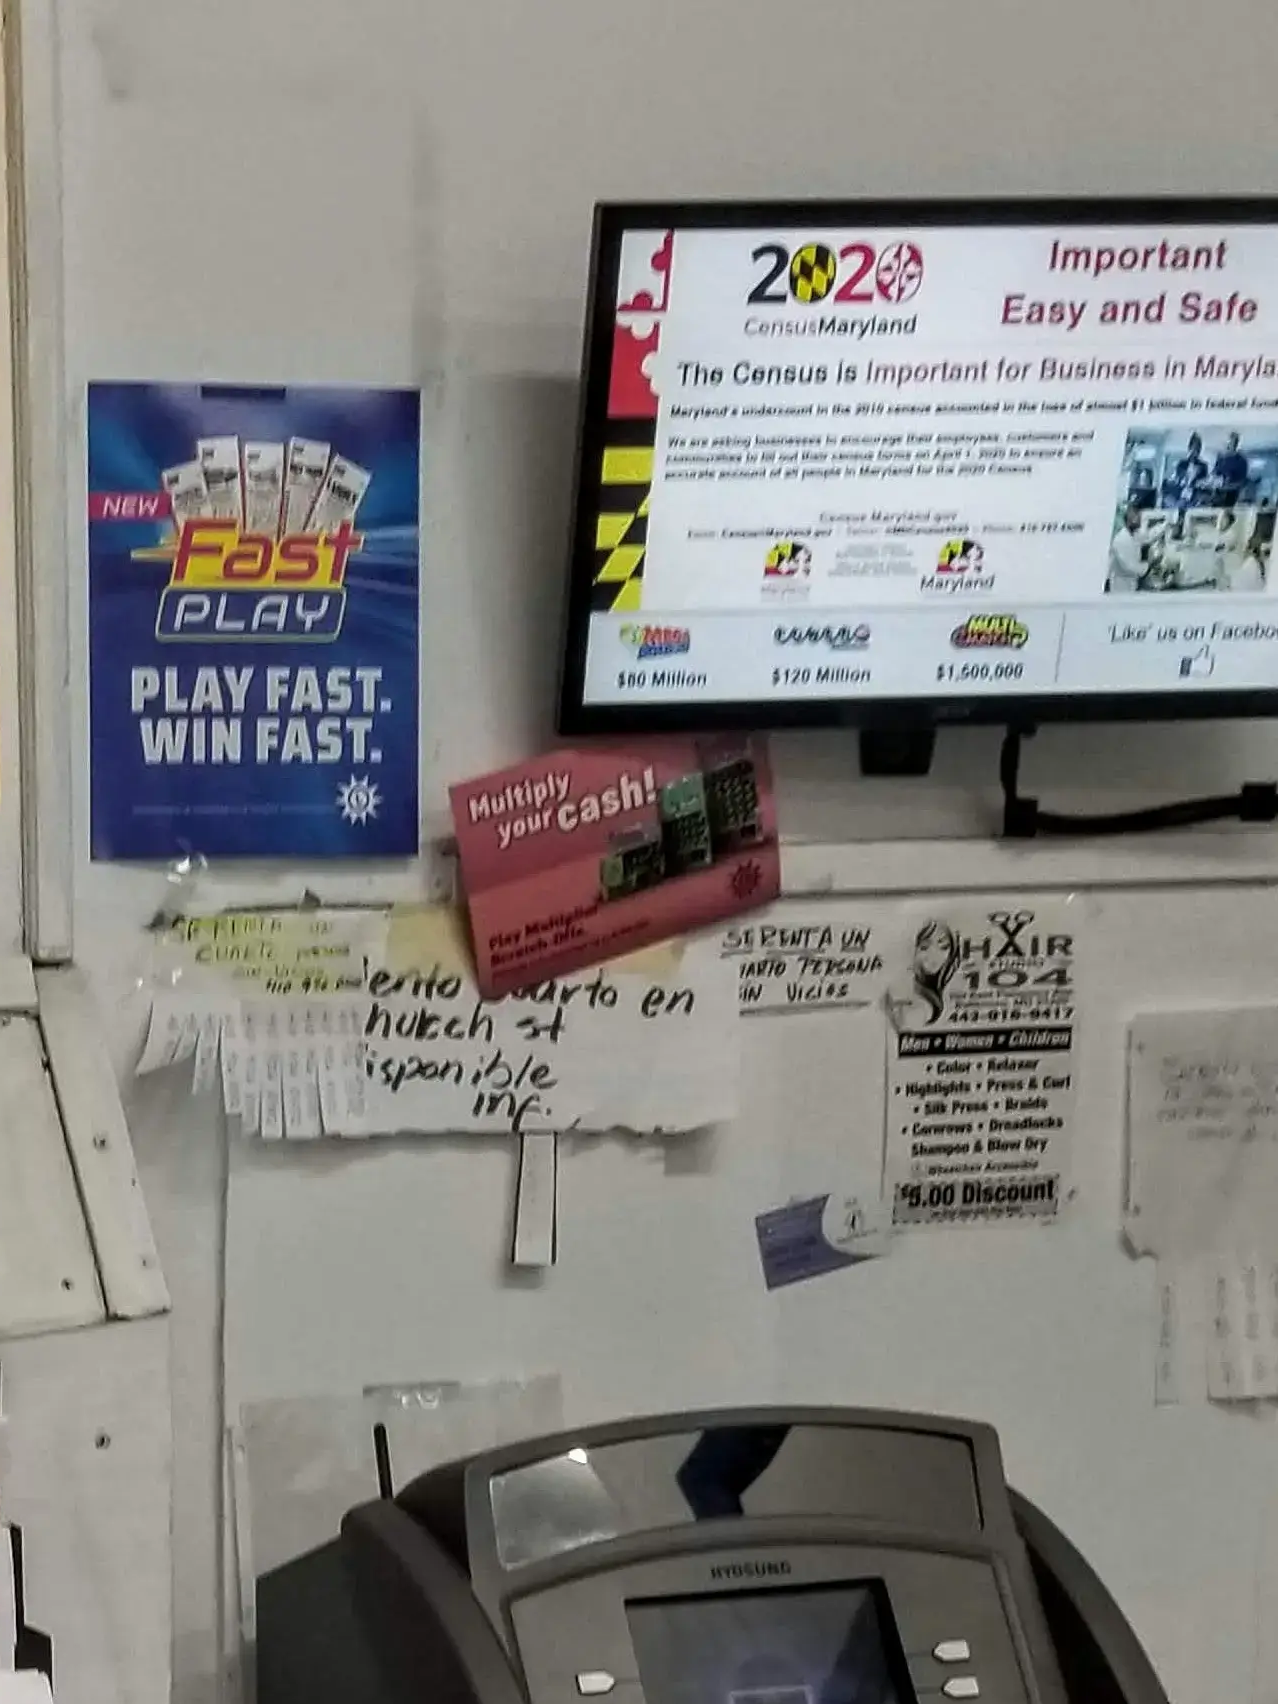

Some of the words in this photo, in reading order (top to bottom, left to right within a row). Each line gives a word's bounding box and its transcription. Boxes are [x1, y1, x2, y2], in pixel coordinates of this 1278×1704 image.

[1048, 239, 1228, 275] Important
[1000, 294, 1088, 331] Easy
[1099, 293, 1166, 325] and
[1178, 291, 1258, 324] Safe
[678, 361, 724, 387] The
[731, 360, 829, 387] Census
[836, 360, 859, 386] is
[865, 357, 989, 389] Important
[997, 356, 1032, 382] for
[1039, 356, 1155, 382] Business
[1164, 355, 1186, 380] in
[102, 494, 159, 518] NEW
[173, 518, 363, 584] Fast
[920, 573, 996, 594] Maryland
[173, 593, 331, 633] PLAY
[1157, 624, 1178, 641] us
[1182, 623, 1206, 640] on
[130, 665, 255, 714] PLAY
[265, 665, 393, 714] FAST.
[651, 668, 707, 687] Million
[771, 669, 812, 687] $120
[815, 666, 871, 684] Million
[138, 717, 242, 766] WIN
[256, 716, 383, 765] FAST.
[468, 772, 571, 824] Multiply
[496, 808, 554, 851] your
[363, 956, 462, 998] ento
[641, 986, 696, 1018] en
[964, 967, 1075, 991] 104
[899, 1034, 930, 1053] Men
[944, 1031, 995, 1050] Women
[1007, 1027, 1070, 1047] Children
[905, 1080, 972, 1097] Highlights
[986, 1077, 1024, 1093] Press
[1042, 1074, 1072, 1091] Curl
[951, 1099, 989, 1115] Press
[988, 1115, 1064, 1133] Dreadlocks
[1023, 1136, 1049, 1154] Dry
[962, 1178, 1055, 1206] Discount
